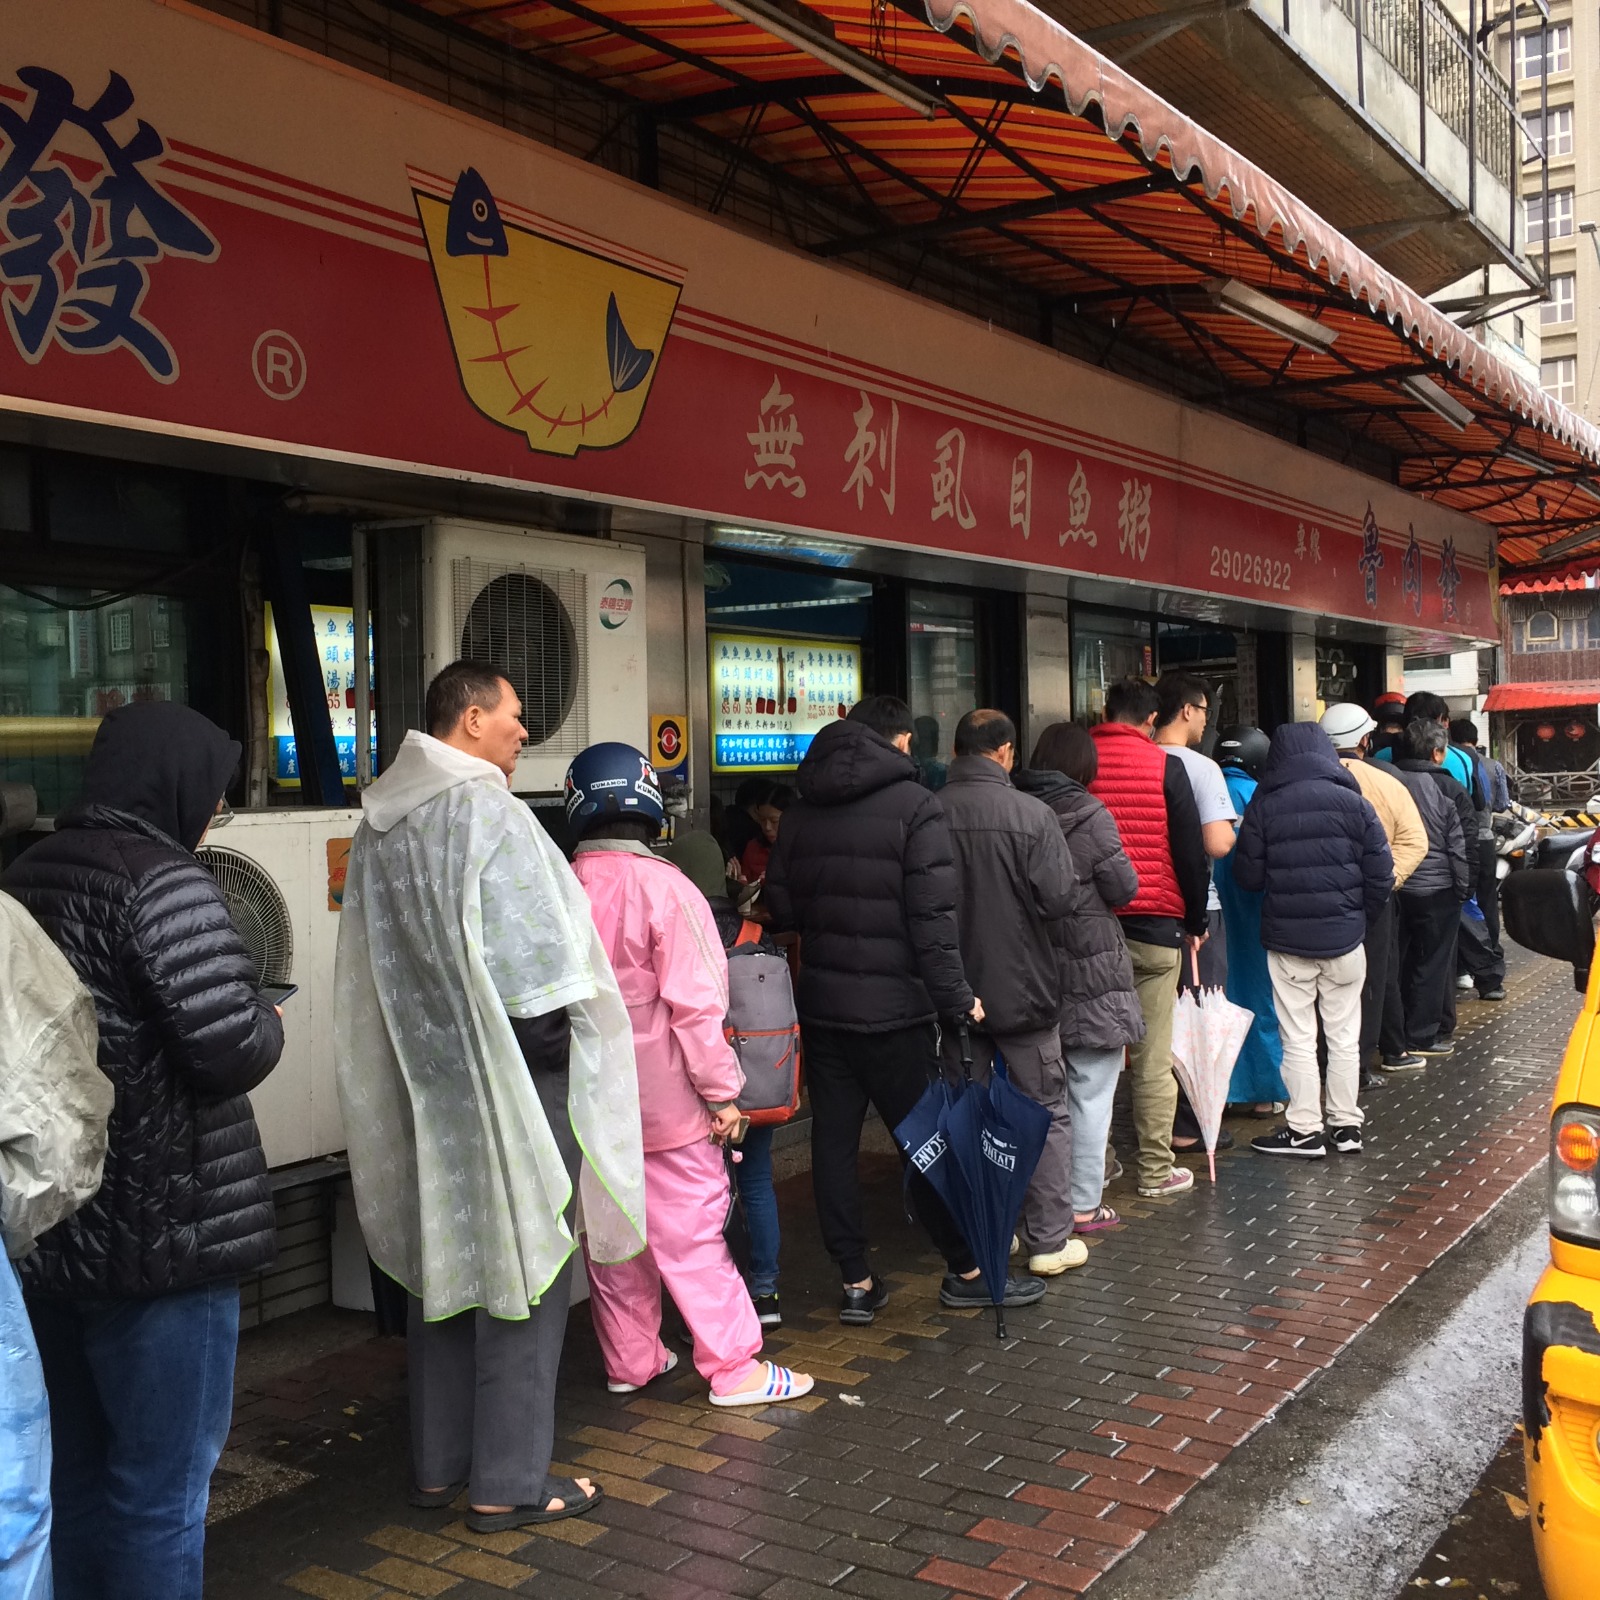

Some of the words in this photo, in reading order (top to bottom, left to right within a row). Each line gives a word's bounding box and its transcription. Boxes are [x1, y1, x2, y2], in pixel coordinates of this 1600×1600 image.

[1210, 545, 1291, 591] 29026322
[591, 780, 627, 789] KUMAMON
[981, 1137, 1016, 1171] LIVING
